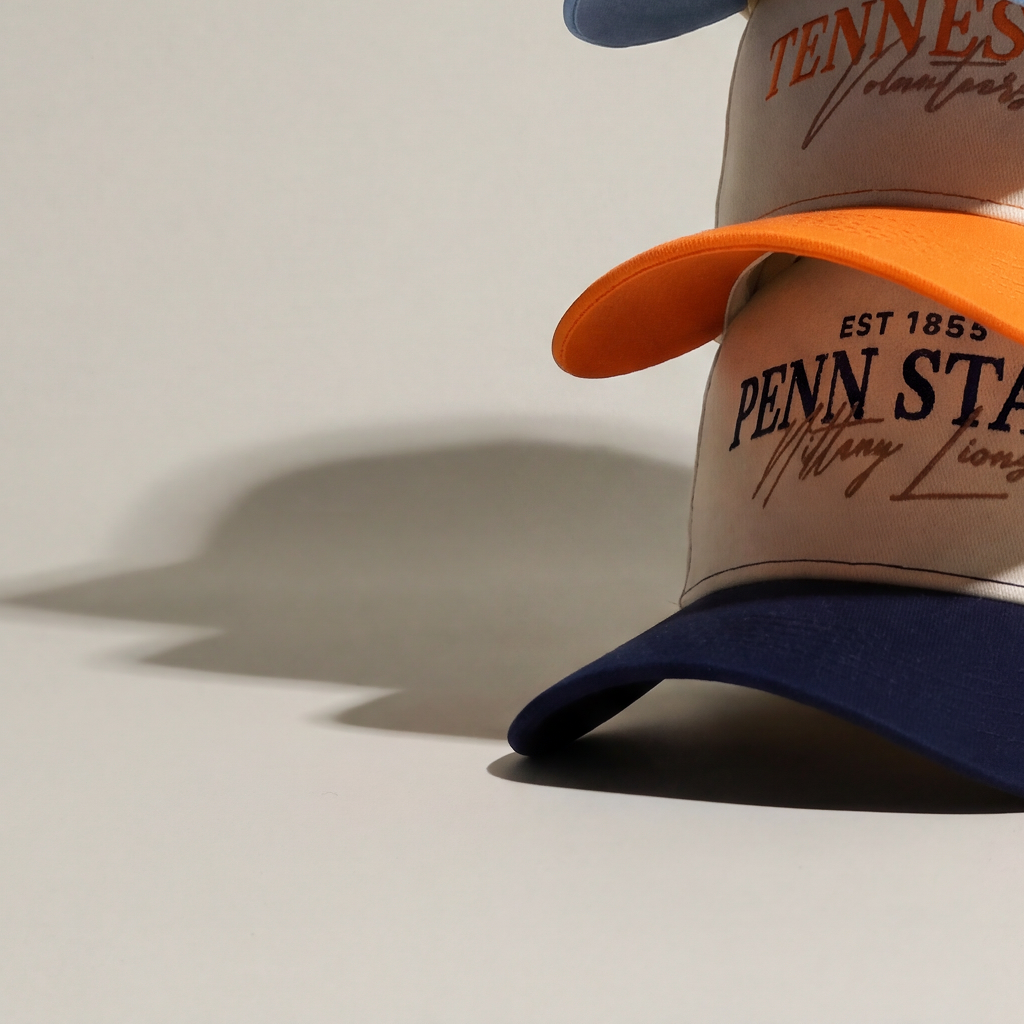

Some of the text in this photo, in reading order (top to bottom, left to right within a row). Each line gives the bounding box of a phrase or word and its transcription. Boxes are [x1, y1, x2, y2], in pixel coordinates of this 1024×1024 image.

[839, 311, 988, 342] EST 1855
[729, 347, 879, 451] PENN
[752, 401, 904, 510] Nittany
